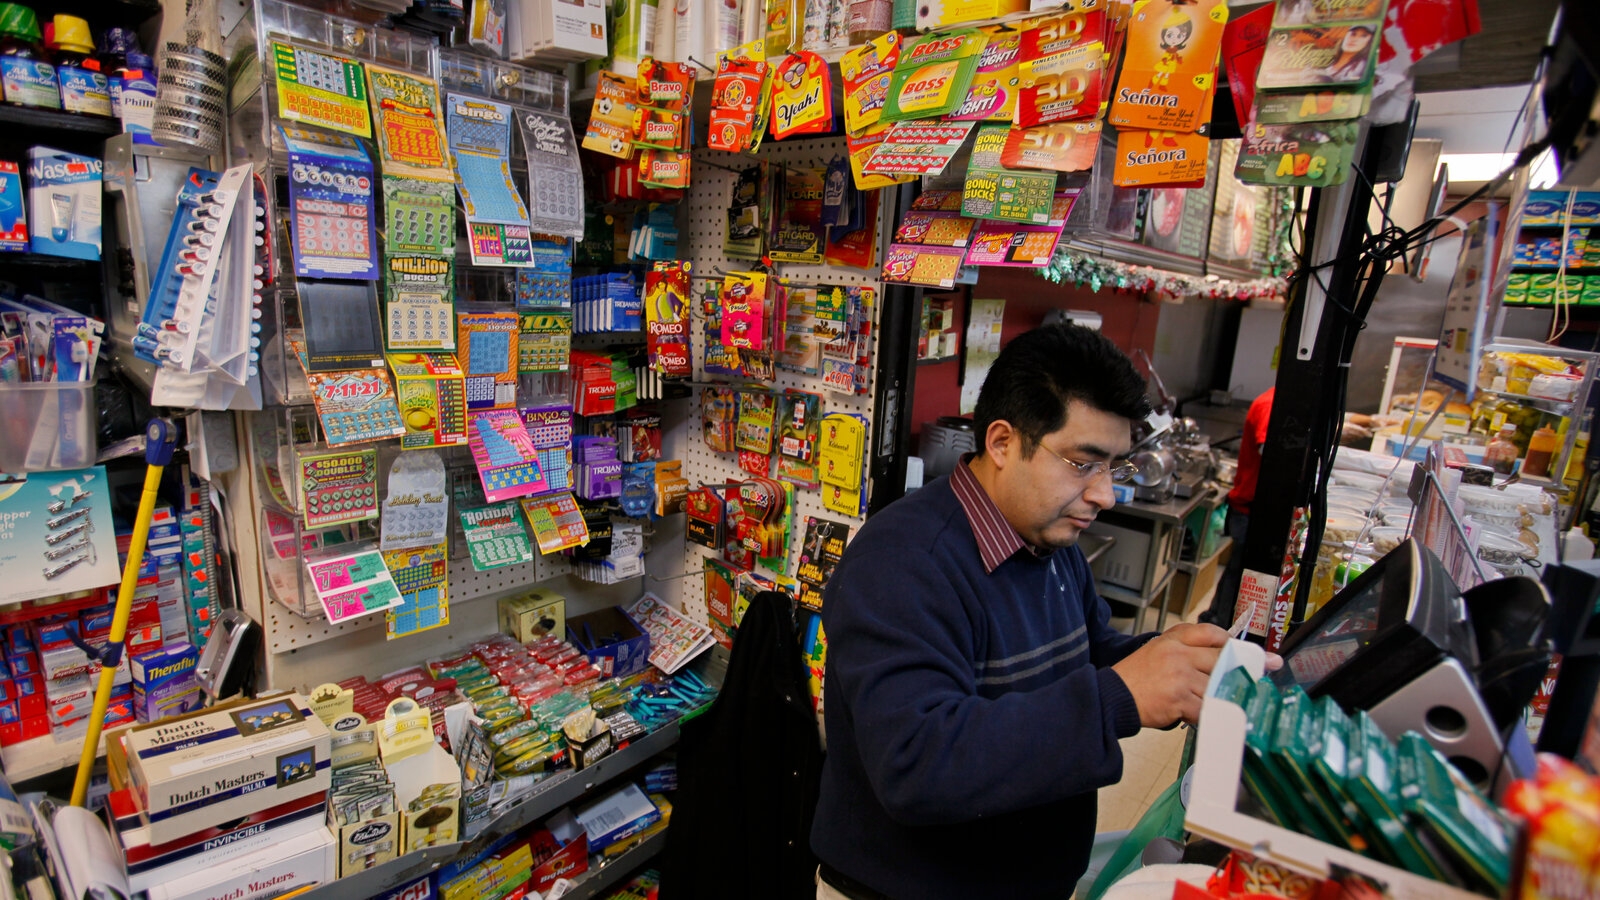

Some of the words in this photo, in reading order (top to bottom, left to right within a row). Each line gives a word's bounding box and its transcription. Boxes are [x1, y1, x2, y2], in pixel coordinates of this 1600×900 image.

[909, 36, 965, 59] BOSS
[651, 81, 681, 93] Bravo
[902, 76, 947, 95] BOSS
[601, 88, 625, 98] AFRICA
[1118, 87, 1179, 108] Señora
[455, 103, 504, 121] Bingo
[777, 87, 820, 127] Yeah!
[600, 127, 625, 139] AFRICA
[647, 123, 674, 133] Bravo
[1126, 148, 1187, 167] Señora
[654, 160, 680, 172] Bravo
[1275, 153, 1327, 179] ABC
[965, 179, 997, 192] BONUS
[964, 189, 995, 202] BUCKS
[472, 225, 497, 237] WIN
[479, 239, 500, 255] LIFE
[391, 256, 449, 275] MILLION
[403, 273, 437, 282] BUCKS
[523, 315, 567, 330] 10X
[650, 321, 683, 335] ROMEO
[658, 353, 687, 367] ROMEO
[705, 354, 733, 366] AFRICA
[825, 371, 853, 392] .com
[588, 386, 616, 394] TROJAN
[526, 411, 559, 423] BINGO
[316, 465, 363, 477] DOUBLER
[593, 464, 621, 475] TROJAN
[741, 487, 768, 507] maxx
[465, 505, 515, 526] HOLIDAY
[690, 525, 705, 535] BLACK
[742, 538, 762, 551] maxx
[148, 657, 195, 681] Theraflu
[150, 725, 215, 746] Masters
[156, 720, 206, 737] Dutch
[169, 782, 211, 807] Dutch
[214, 769, 266, 796] Masters
[242, 780, 267, 794] PALMA
[203, 823, 267, 851] INVINCIBLE
[248, 872, 296, 895] Masters
